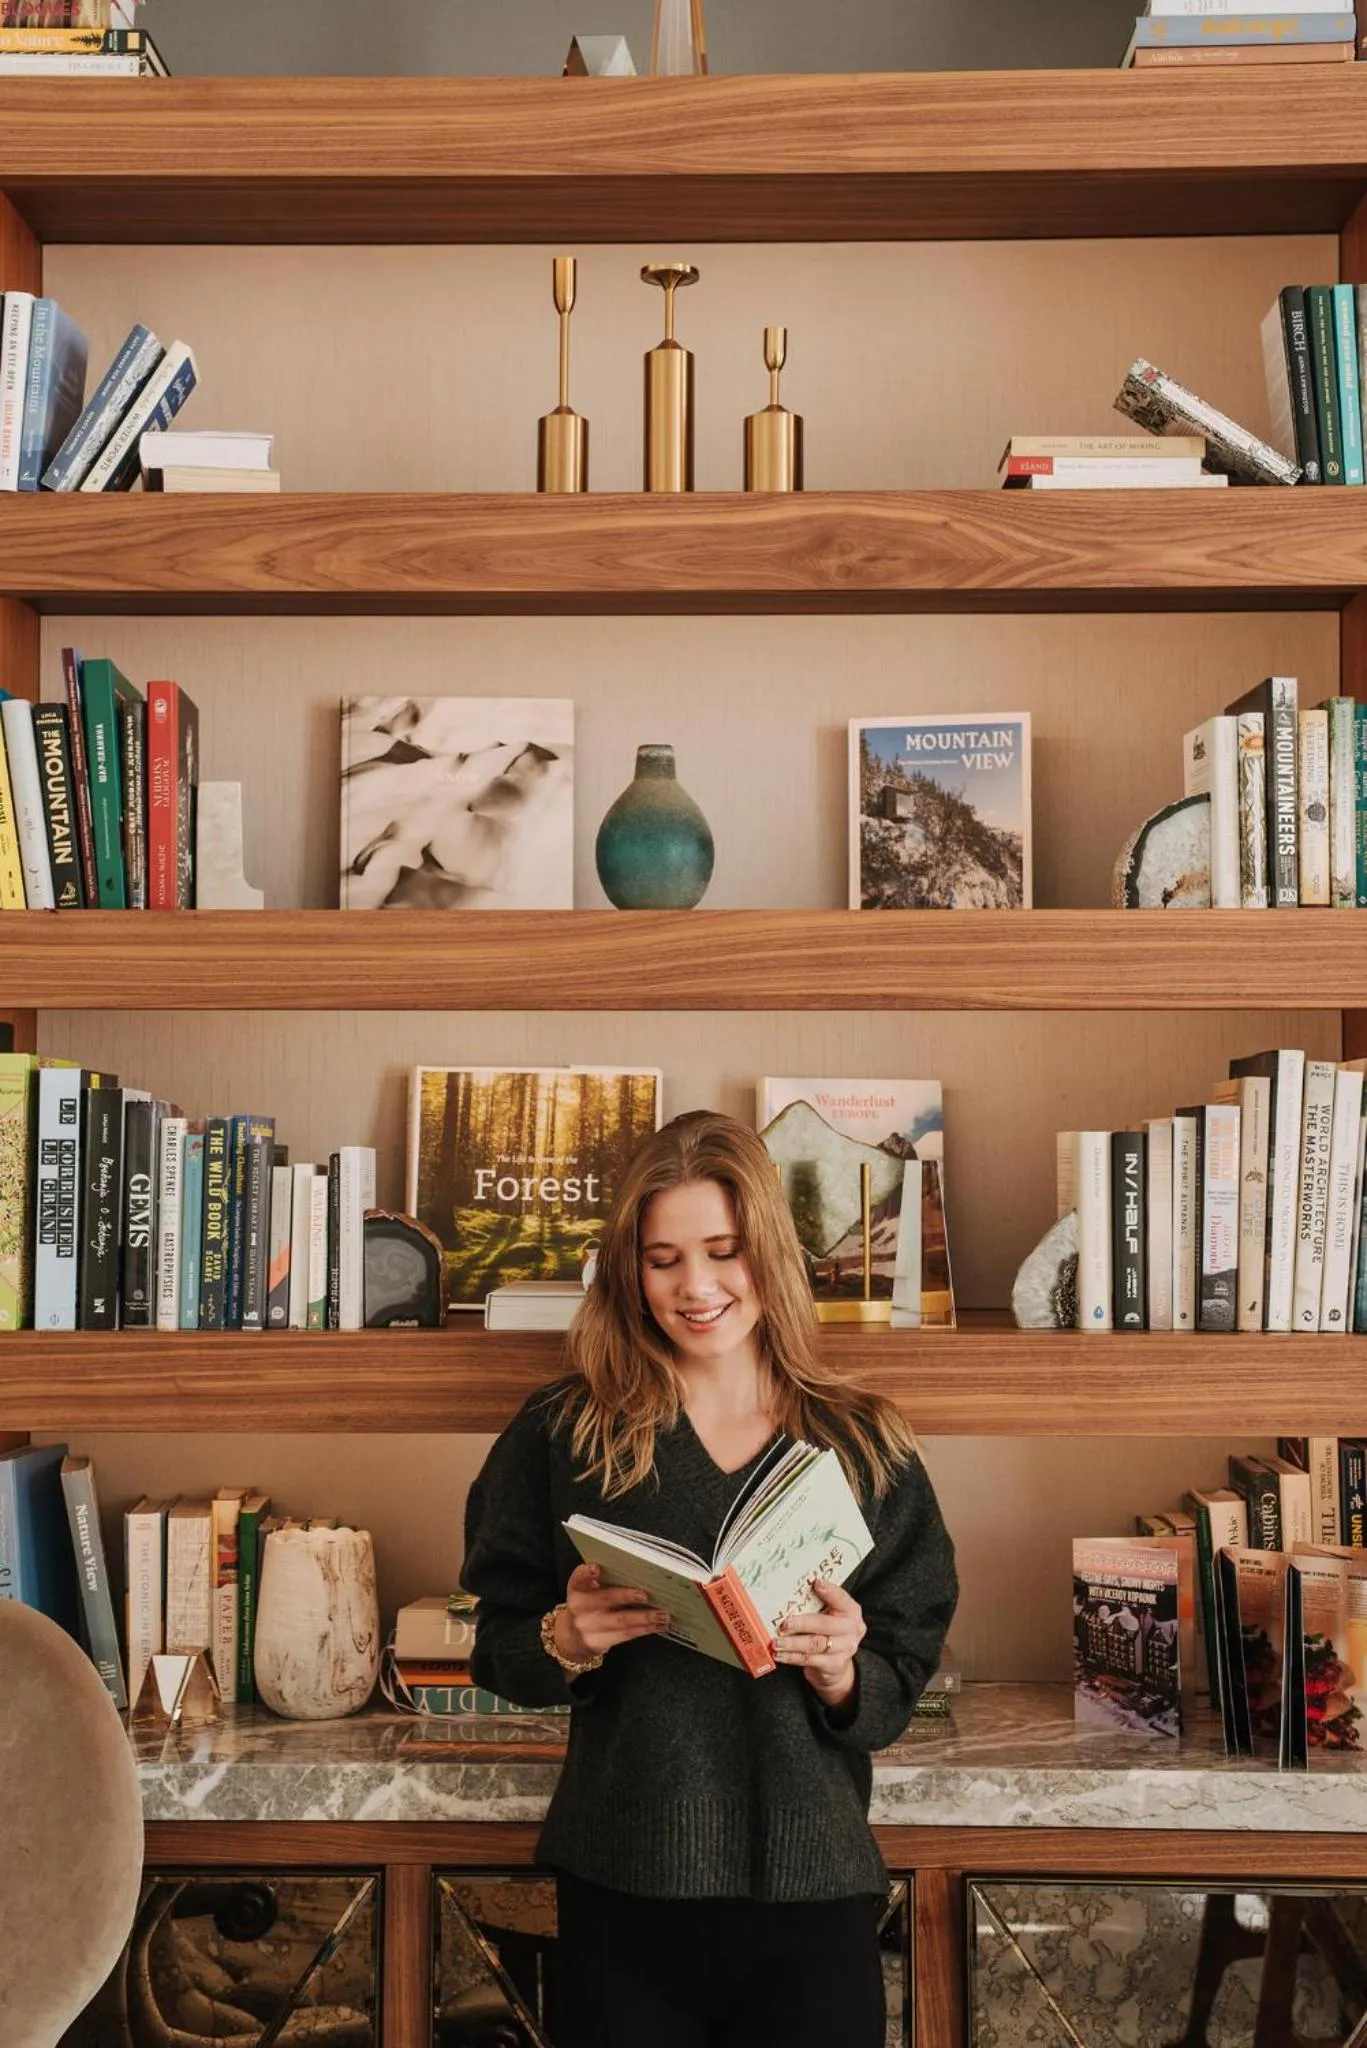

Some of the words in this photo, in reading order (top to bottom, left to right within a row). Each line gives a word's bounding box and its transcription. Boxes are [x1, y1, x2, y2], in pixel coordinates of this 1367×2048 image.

[10, 304, 20, 338] KEEPING
[37, 306, 49, 320] In
[9, 340, 18, 351] AN
[35, 323, 47, 345] the
[1291, 310, 1306, 352] BIRCH
[7, 353, 17, 367] EYE
[6, 369, 16, 391] OPEN
[30, 346, 44, 414] Mountains
[117, 411, 143, 442] WINTER
[98, 441, 123, 472] SPORTS
[42, 729, 60, 741] THE
[906, 730, 1014, 751] MOUNTAIN
[961, 752, 1015, 770] VIEW
[44, 740, 73, 864] MOUNTAIN
[1276, 726, 1296, 856] MOUNTAINEERS
[61, 1098, 77, 1124] LE
[815, 1094, 895, 1108] Wanderlust
[1306, 1104, 1319, 1130] THE
[165, 1125, 178, 1163] CHARLES
[209, 1128, 224, 1154] THE
[1318, 1103, 1331, 1153] WORLD
[42, 1139, 59, 1165] LE
[1181, 1139, 1189, 1157] THE
[164, 1165, 176, 1197] SPENCE
[208, 1160, 223, 1196] WILD
[251, 1167, 260, 1195] SECRET
[474, 1169, 600, 1202] Forest
[1181, 1161, 1189, 1188] SPIRIT
[1301, 1135, 1317, 1241] MASTERWORKS
[1338, 1164, 1351, 1193] THIS
[40, 1178, 57, 1244] GRAND
[57, 1139, 76, 1257] CORBUSIER
[129, 1172, 151, 1248] GEMS
[251, 1198, 260, 1230] LIBRARY
[1311, 1157, 1328, 1263] ARCHITECTURE
[1337, 1196, 1349, 1212] IS
[207, 1202, 222, 1239] BOOK
[312, 1189, 326, 1247] WALKING
[1181, 1193, 1189, 1237] ALMANAC
[1209, 1214, 1222, 1270] Diamond
[1334, 1215, 1348, 1252] HOME
[162, 1231, 176, 1298] GASTROPHYSICS
[203, 1249, 213, 1282] SCARFE
[212, 1253, 222, 1280] DAVID
[1261, 1492, 1279, 1551] Cabins
[76, 1503, 92, 1554] Nature
[84, 1555, 98, 1592] View
[141, 1540, 150, 1563] THE
[141, 1569, 150, 1613] ICONIC
[770, 1544, 842, 1627] NATURE
[222, 1594, 233, 1644] PAPER
[720, 1594, 740, 1621] NATURE
[733, 1617, 753, 1646] REMEDY
